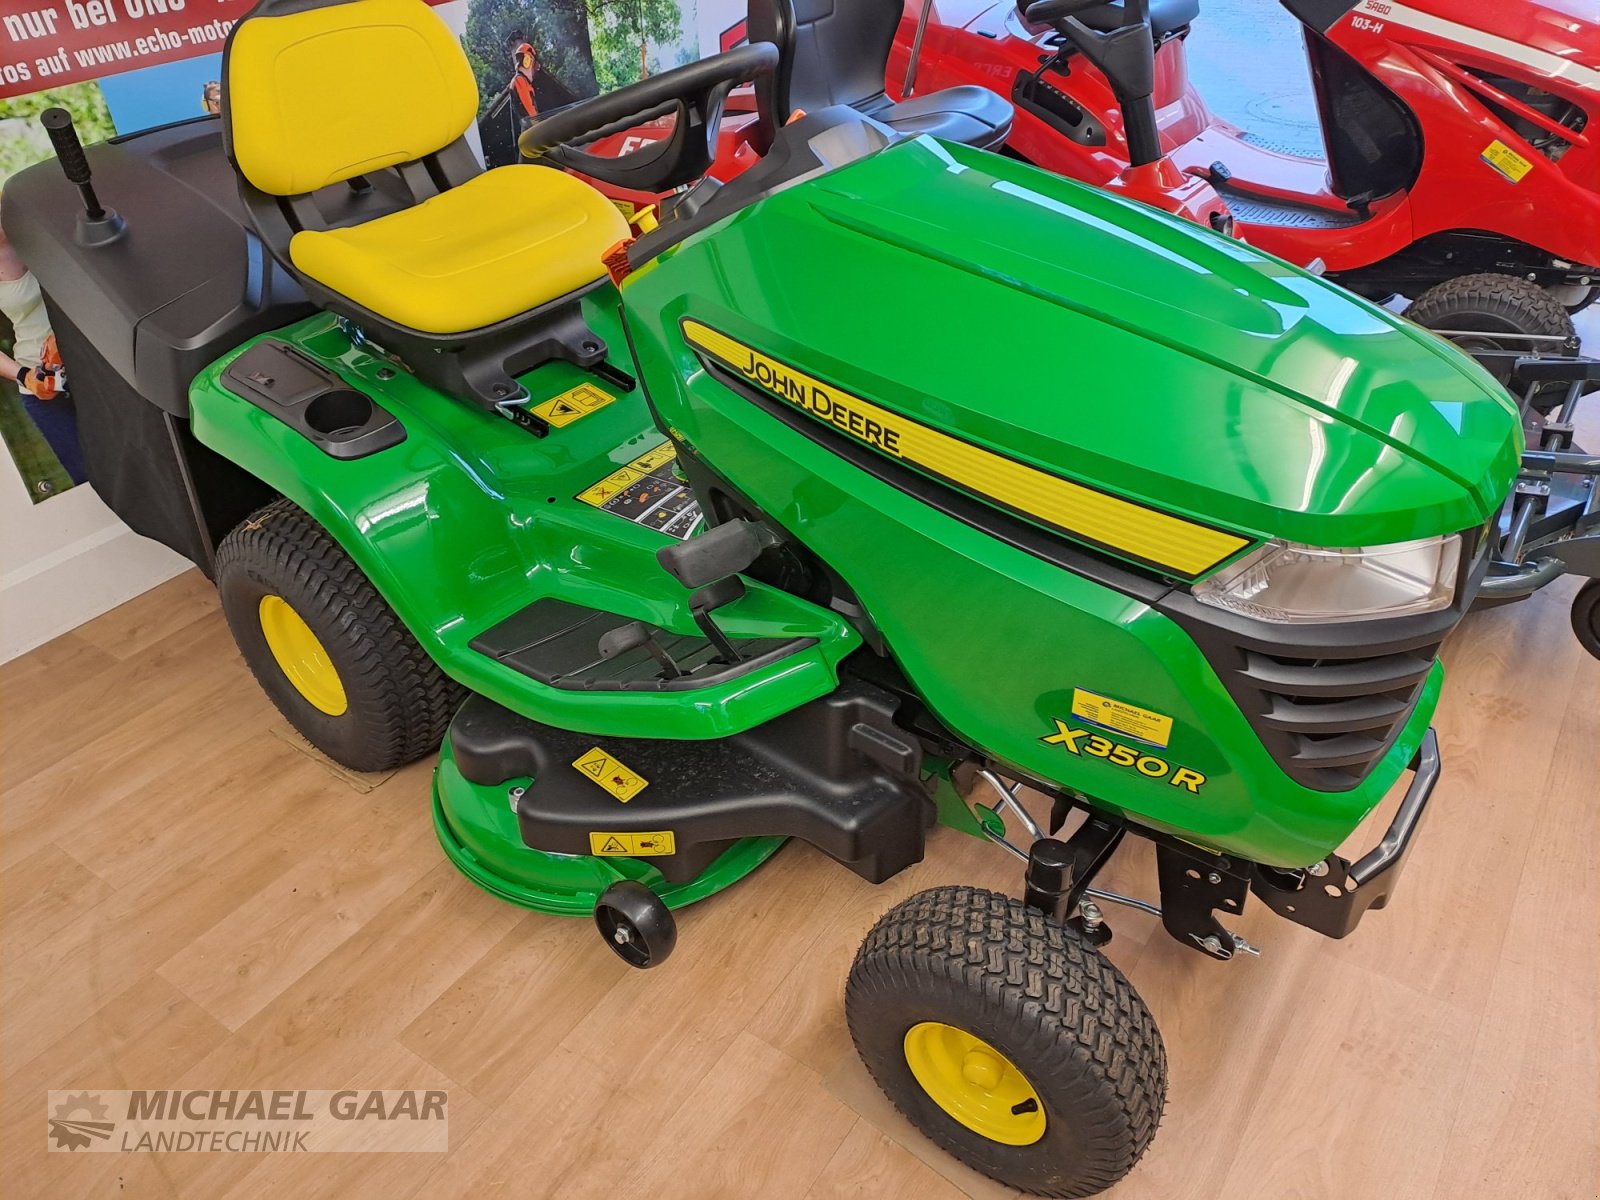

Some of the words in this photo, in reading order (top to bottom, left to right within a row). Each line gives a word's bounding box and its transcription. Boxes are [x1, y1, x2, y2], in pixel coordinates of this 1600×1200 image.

[2, 7, 58, 42] nur
[64, 0, 117, 30] bei
[1351, 15, 1384, 34] 103-H
[1365, 0, 1392, 15] SABO
[35, 46, 71, 77] auf
[73, 18, 239, 68] www.echo-moto
[742, 352, 806, 405] JOHN
[811, 386, 900, 454] DEERE
[1040, 717, 1170, 778] X350
[1169, 766, 1207, 794] R
